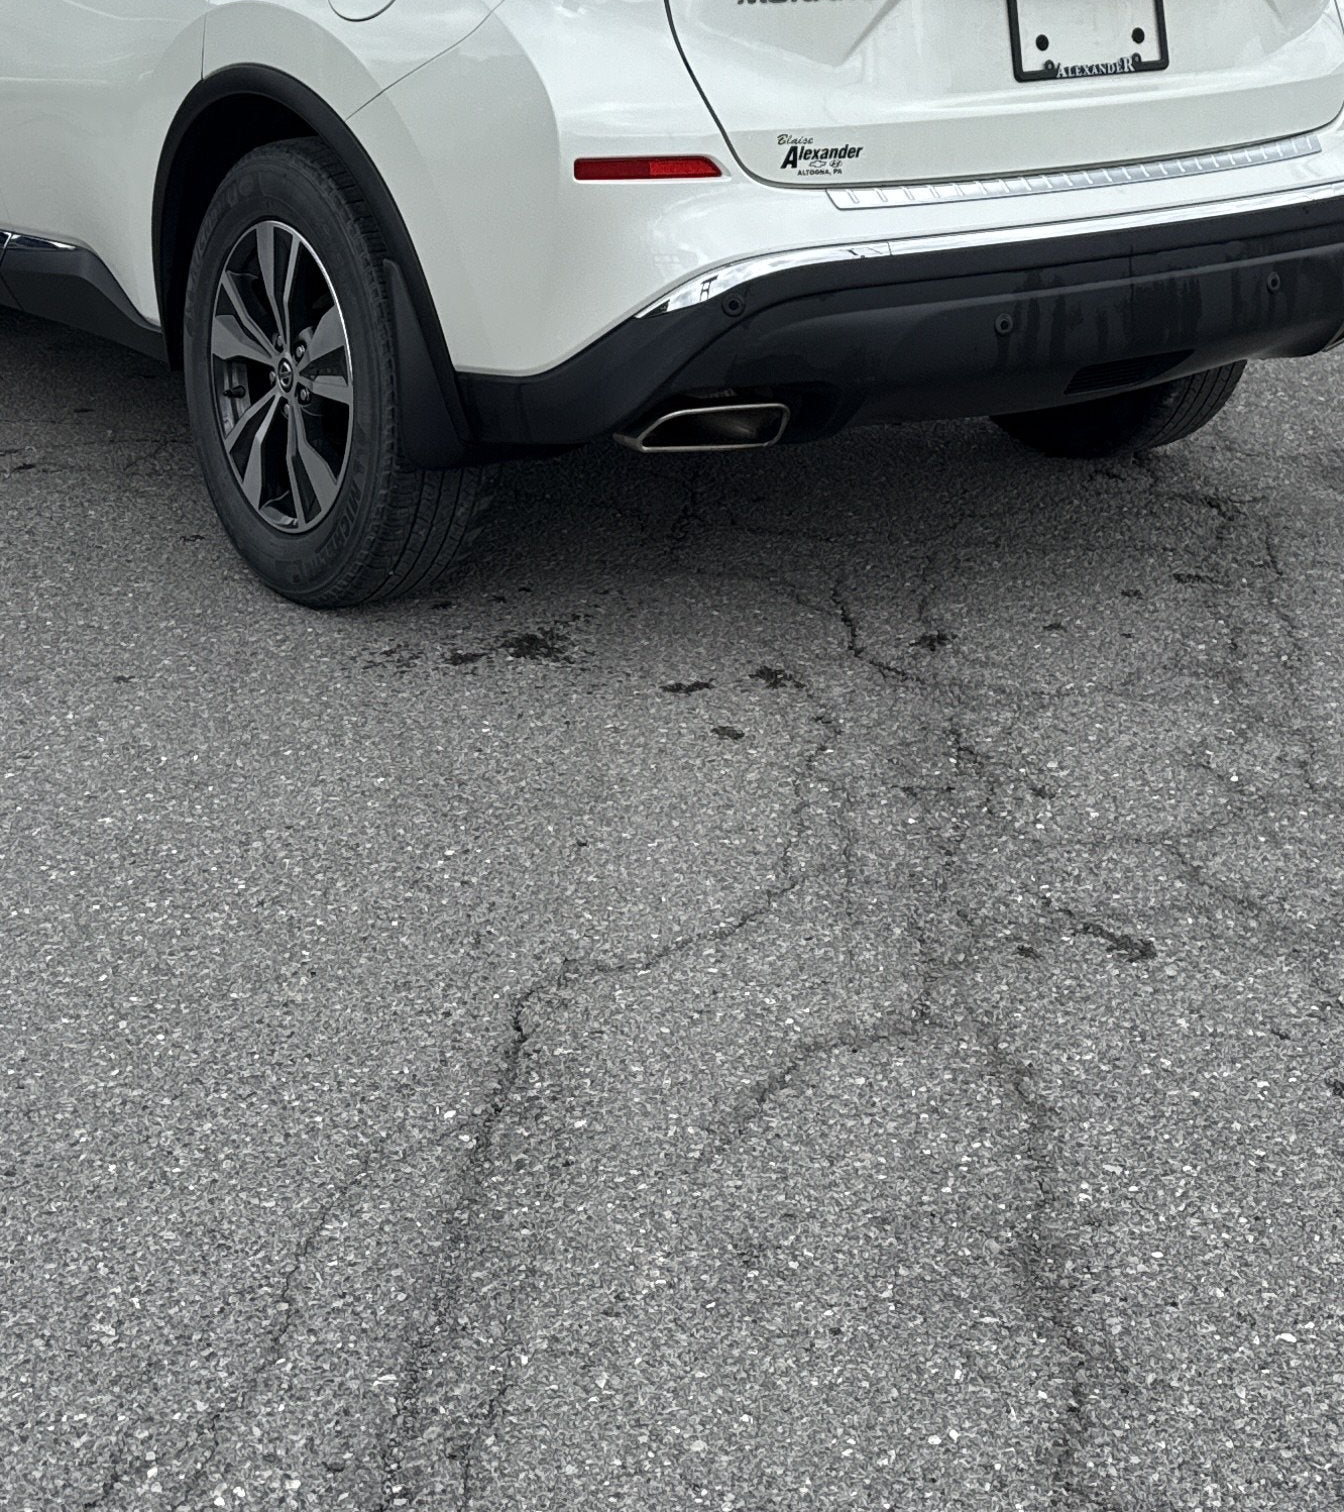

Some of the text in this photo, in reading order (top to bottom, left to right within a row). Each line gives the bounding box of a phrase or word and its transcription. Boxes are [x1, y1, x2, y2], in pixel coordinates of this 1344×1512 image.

[1056, 56, 1135, 79] ALEXANDER
[777, 133, 814, 146] Blaise
[780, 144, 864, 169] Alexander
